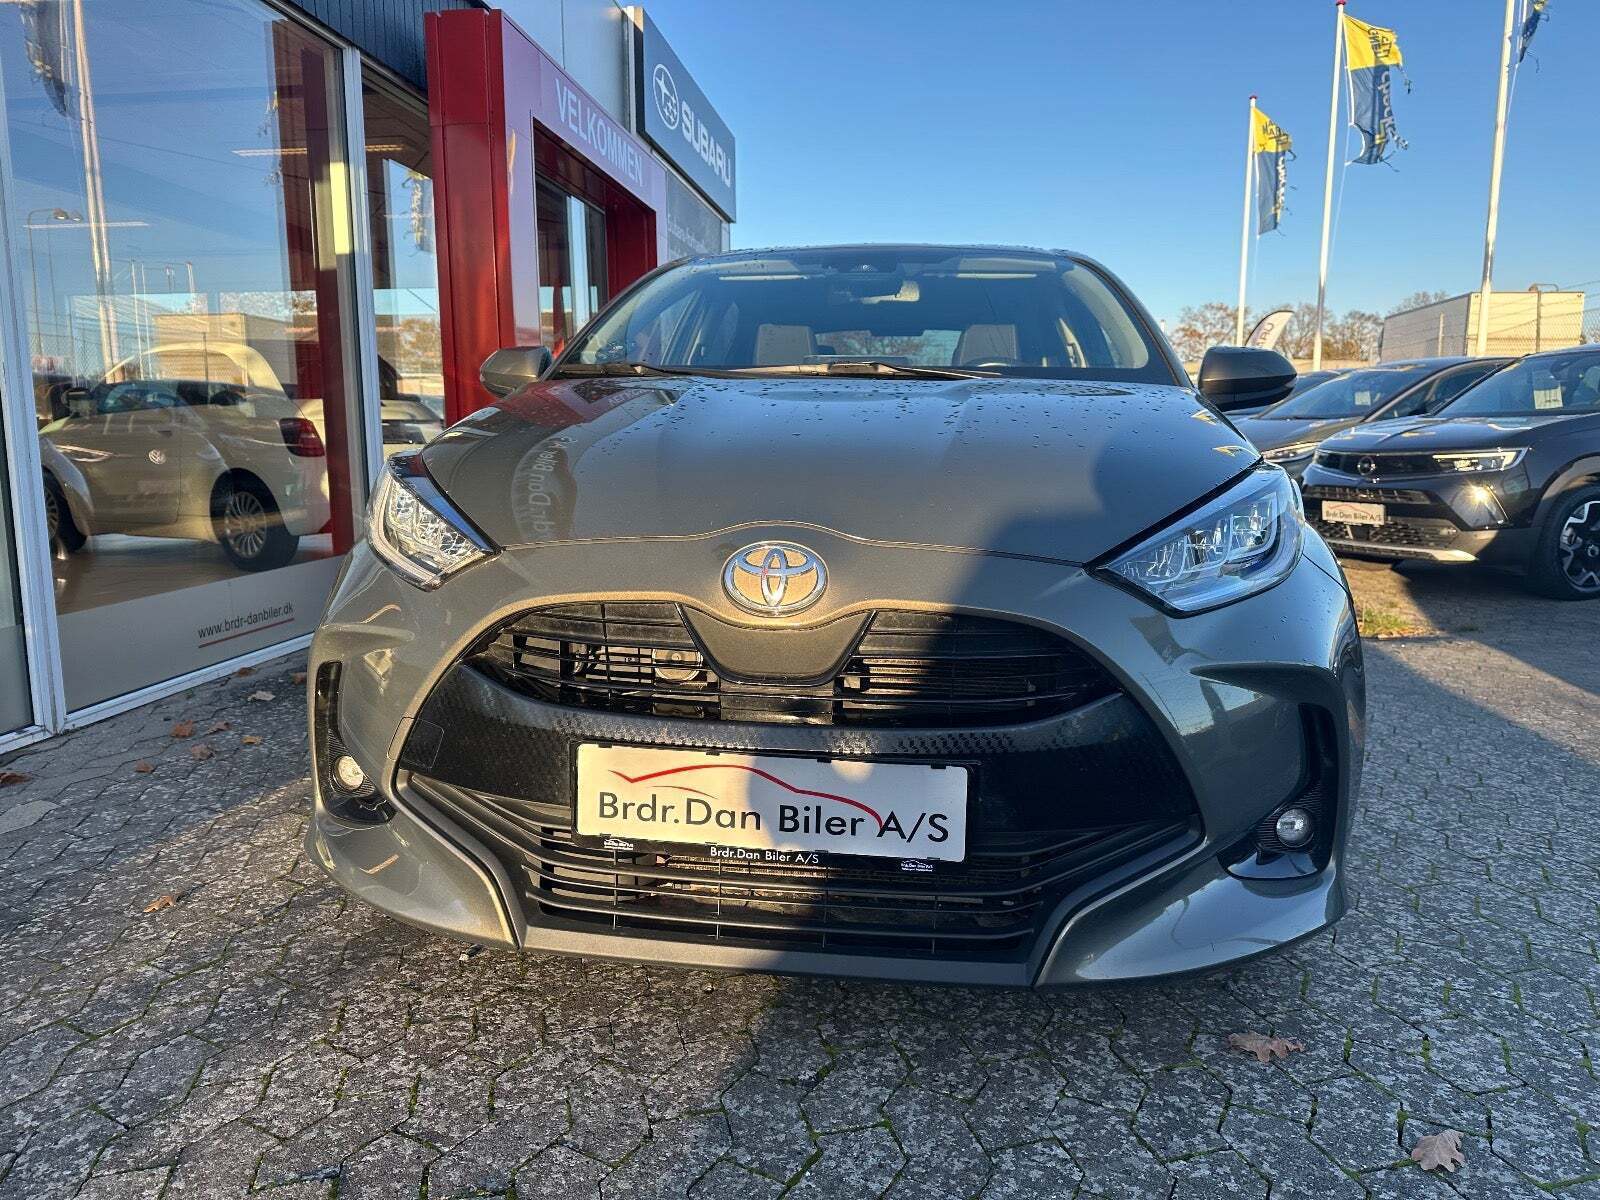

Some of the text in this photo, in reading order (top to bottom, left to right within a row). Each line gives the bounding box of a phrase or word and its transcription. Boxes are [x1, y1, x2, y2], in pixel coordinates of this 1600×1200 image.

[555, 79, 643, 187] VELKOMMEN
[682, 101, 731, 188] SUBARU
[197, 601, 294, 638] www.brdr-danbiler.dk
[599, 791, 949, 844] Brdr.Dan Biler A/S
[710, 846, 819, 865] Brdr.Dan Biler A/S
